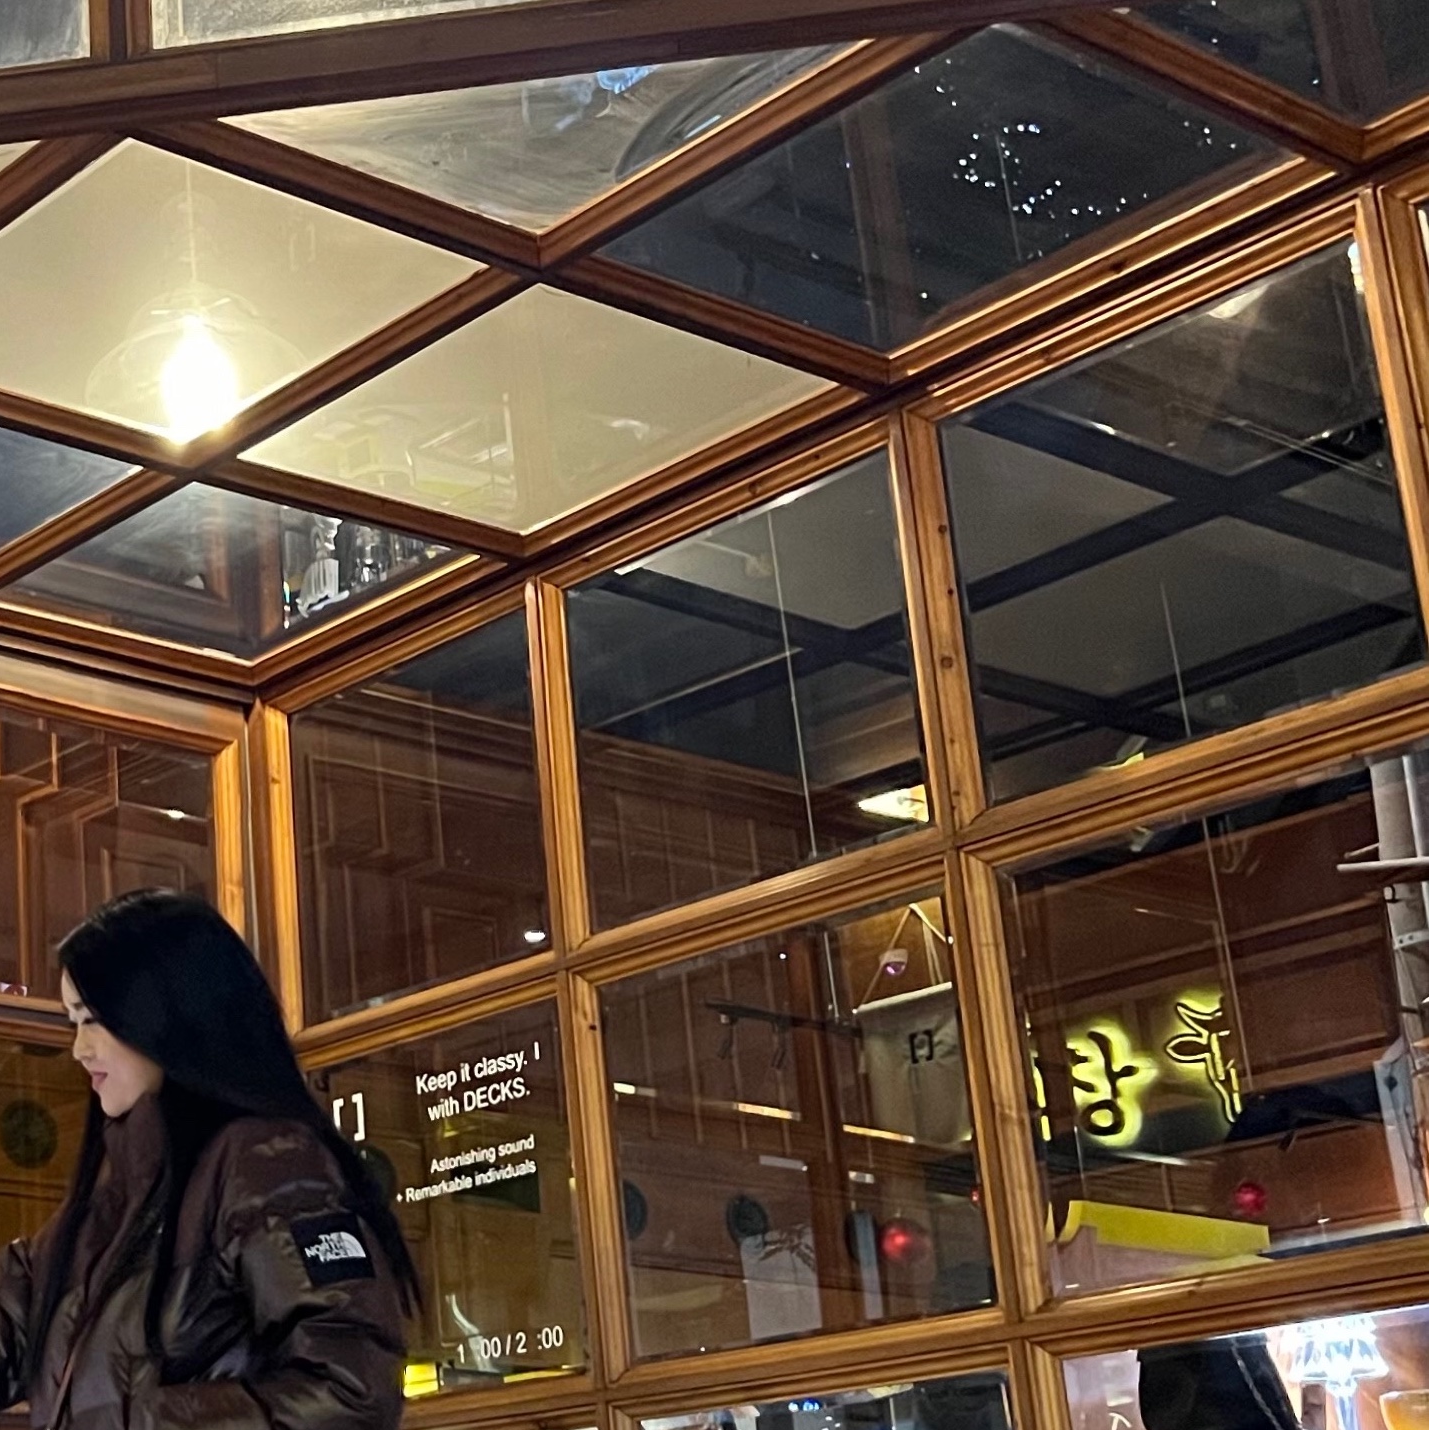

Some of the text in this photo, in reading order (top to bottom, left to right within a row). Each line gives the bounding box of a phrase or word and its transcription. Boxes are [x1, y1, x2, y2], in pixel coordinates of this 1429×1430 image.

[416, 1070, 457, 1095] Keep
[460, 1063, 471, 1082] it
[474, 1050, 528, 1079] classy.
[427, 1076, 531, 1121] with DECKS.
[430, 1133, 535, 1174] Astonishing sound
[405, 1174, 473, 1203] Remarkable
[474, 1159, 537, 1187] individuals
